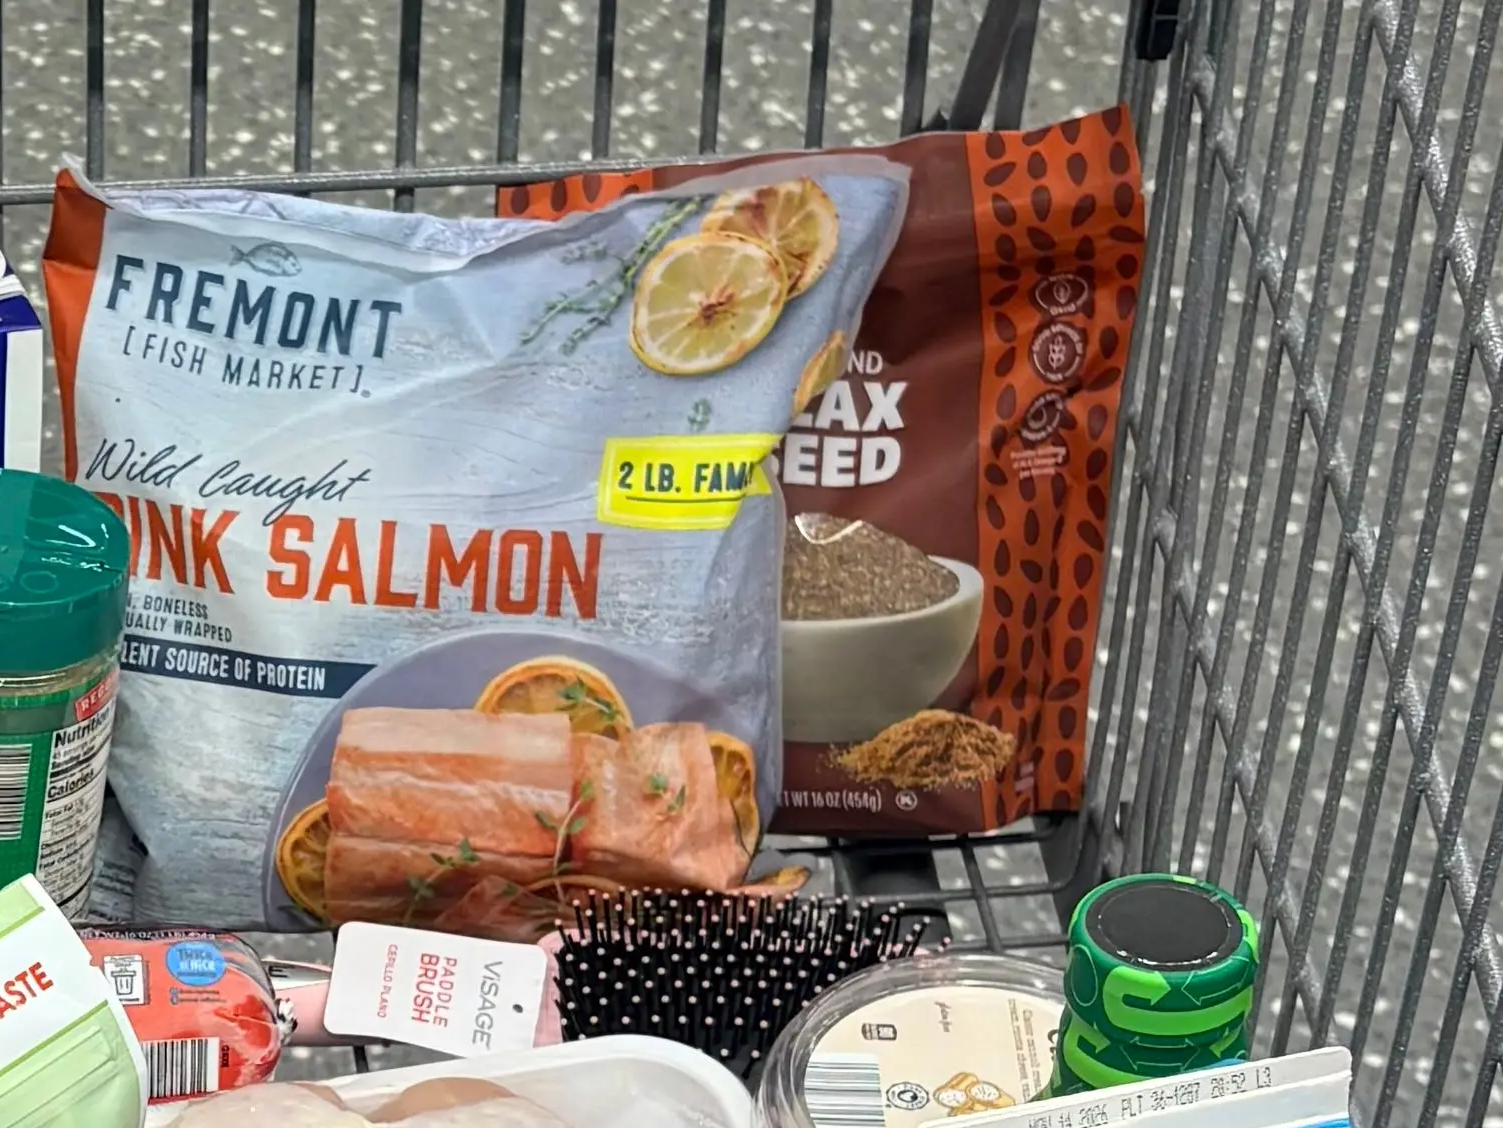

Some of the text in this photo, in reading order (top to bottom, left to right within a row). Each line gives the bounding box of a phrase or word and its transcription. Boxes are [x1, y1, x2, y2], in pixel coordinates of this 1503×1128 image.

[104, 254, 403, 359] FREMONT
[84, 435, 192, 489] Wild
[617, 461, 681, 493] 2 LB.
[265, 514, 604, 619] SALMON
[142, 594, 209, 620] BONELESS
[172, 619, 233, 643] WRAPPED
[164, 647, 230, 679] SOURCE
[233, 657, 252, 681] OF
[257, 661, 326, 691] PROTEIN
[47, 768, 95, 800] Calories
[410, 952, 441, 1025] BRUSH
[432, 956, 458, 1029] PADDLE
[472, 960, 505, 1051] VISAGE
